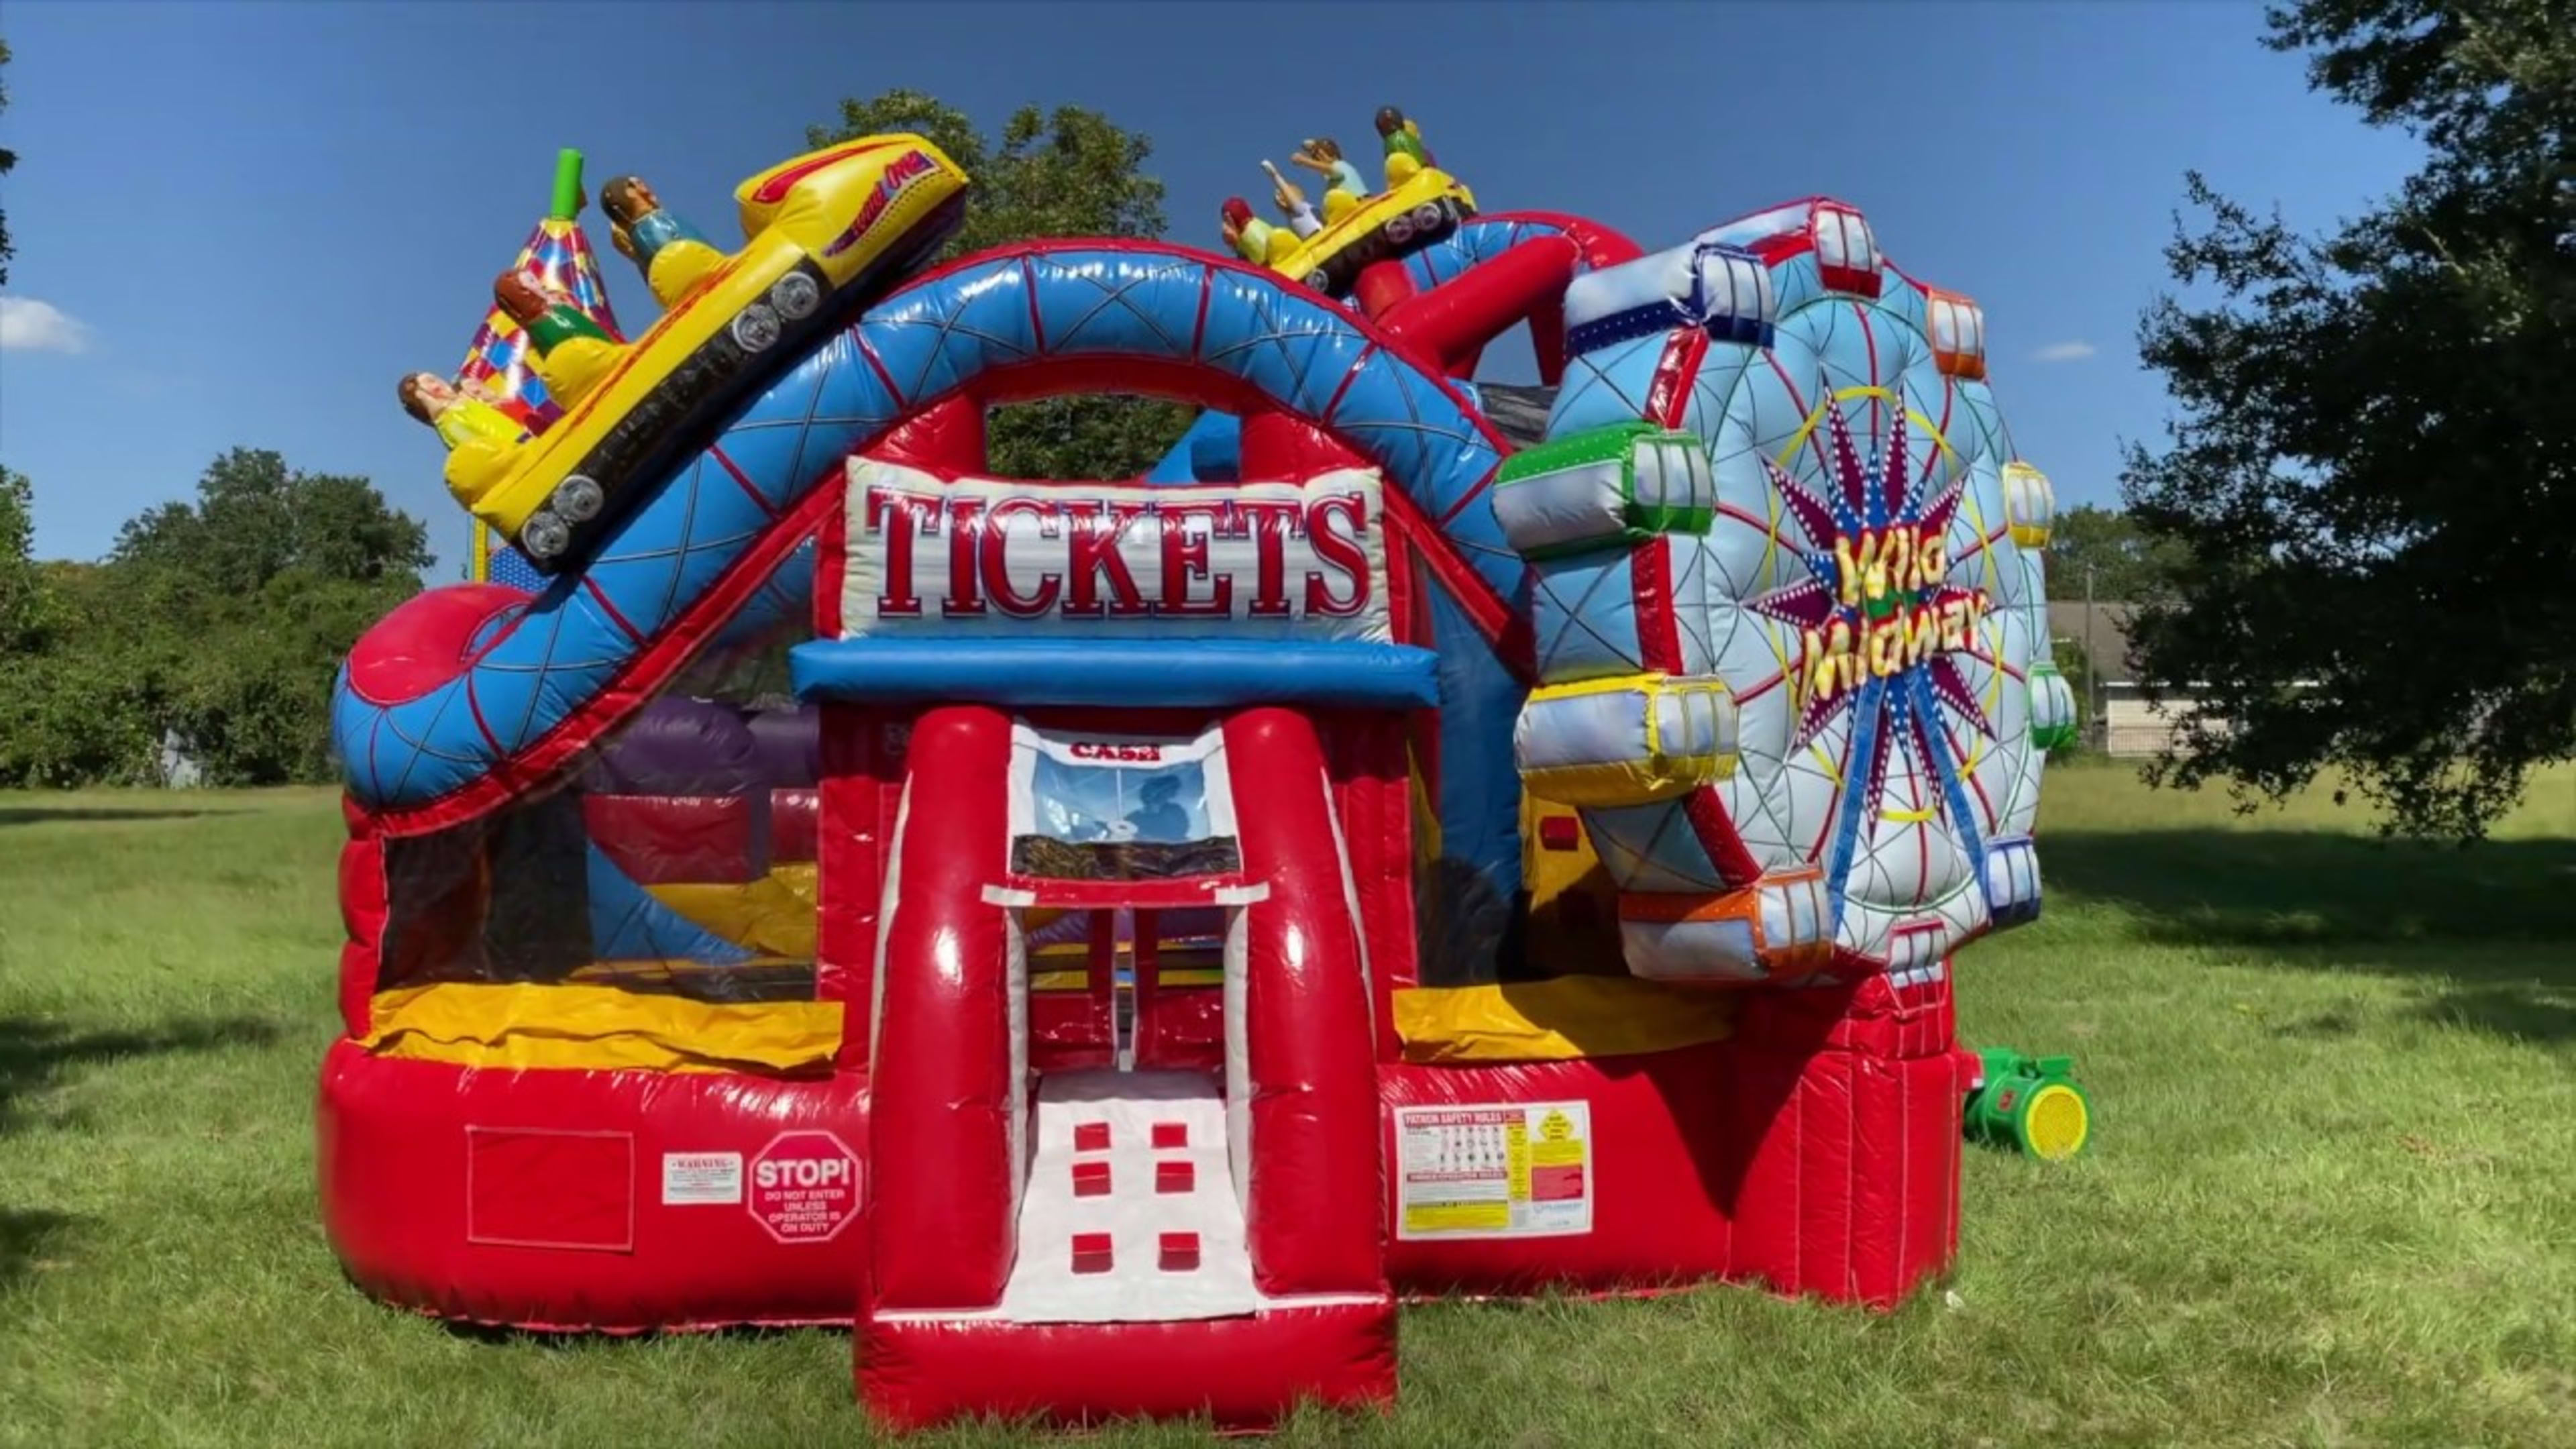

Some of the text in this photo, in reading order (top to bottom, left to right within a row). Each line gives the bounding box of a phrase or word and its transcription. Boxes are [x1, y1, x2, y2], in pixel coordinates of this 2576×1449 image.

[867, 484, 1373, 620] TICKETS
[1442, 1112, 1472, 1124] SAFETY
[1476, 1110, 1503, 1123] RULES
[757, 1159, 850, 1187] STOP!
[765, 1189, 845, 1201] DO NOT ENTER
[784, 1201, 826, 1212] UNLESS
[768, 1211, 841, 1224] OPERATOR IS
[780, 1222, 830, 1233] ON DUTY
